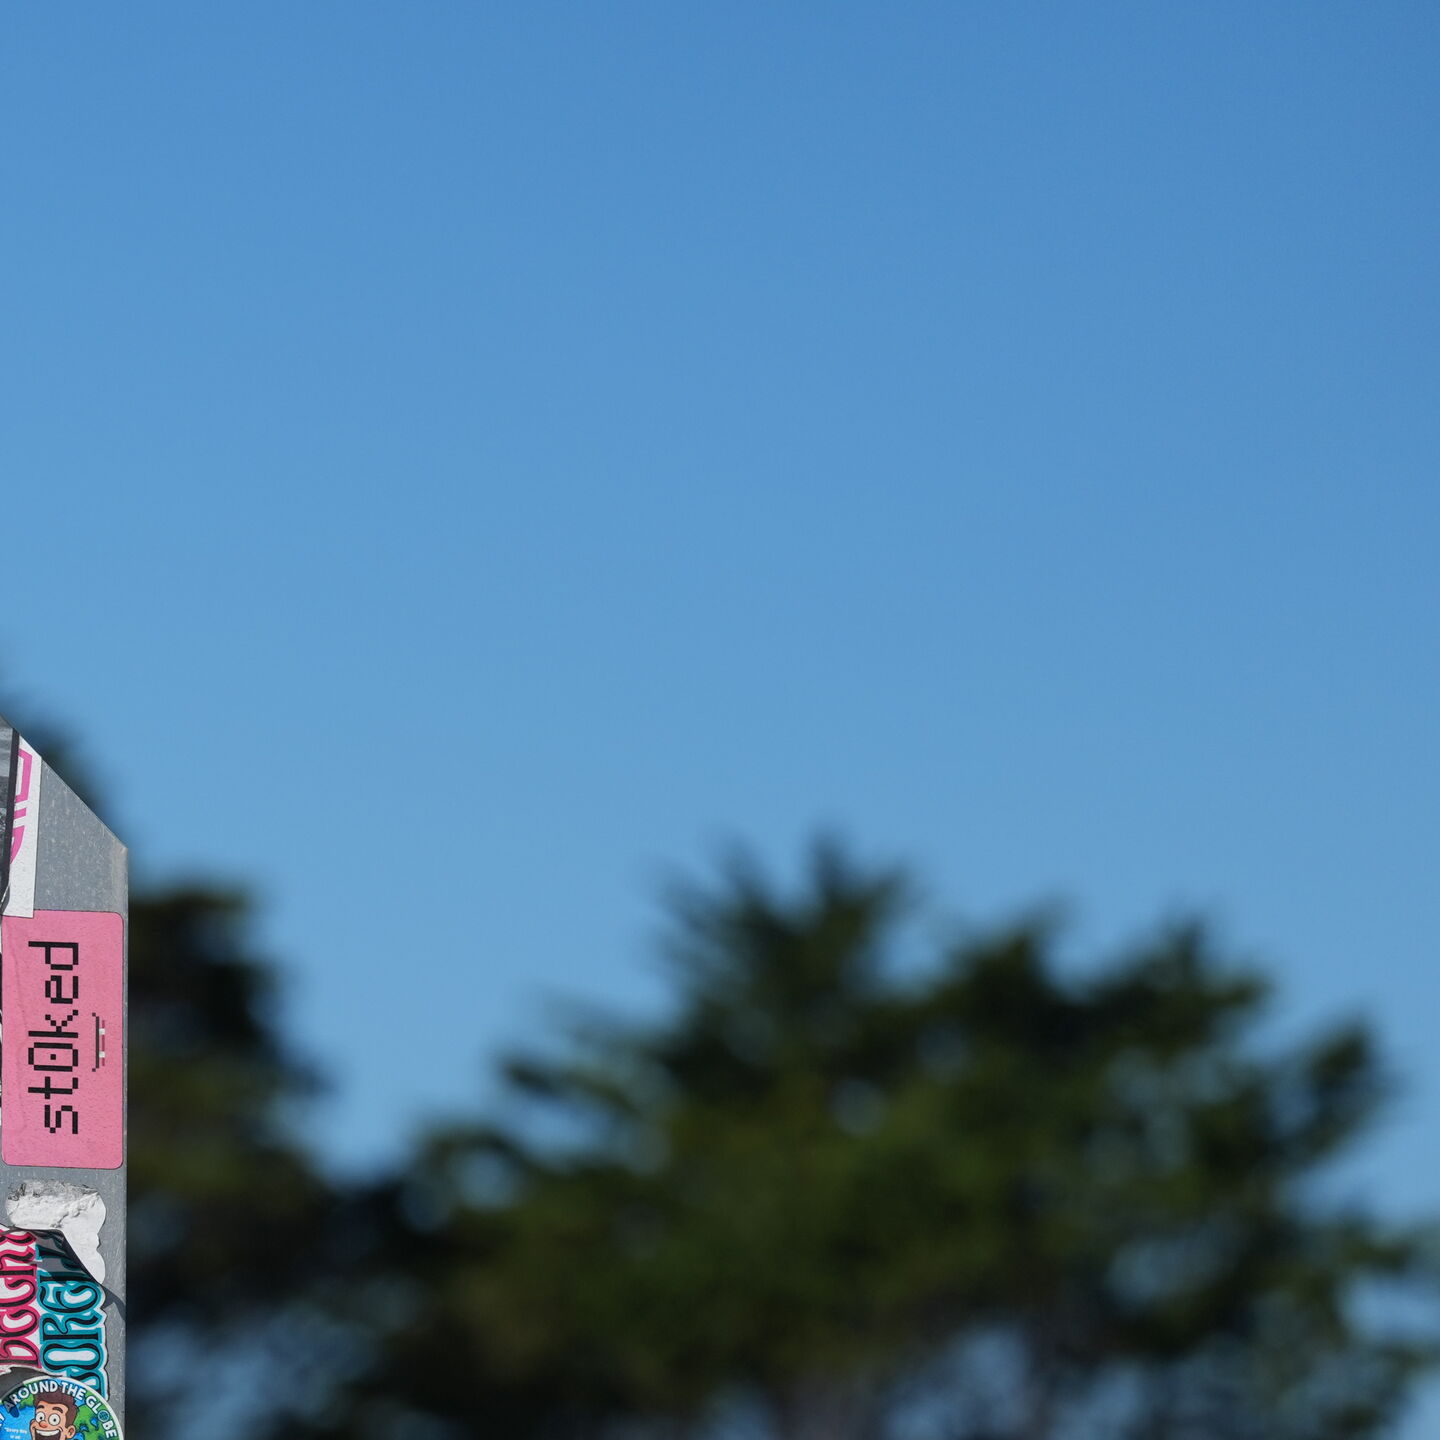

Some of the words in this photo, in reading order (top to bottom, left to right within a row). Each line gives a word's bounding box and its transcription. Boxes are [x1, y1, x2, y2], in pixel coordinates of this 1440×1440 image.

[4, 1381, 58, 1412] AROUND
[61, 1381, 87, 1401] THE
[85, 1395, 118, 1439] GLOBE
